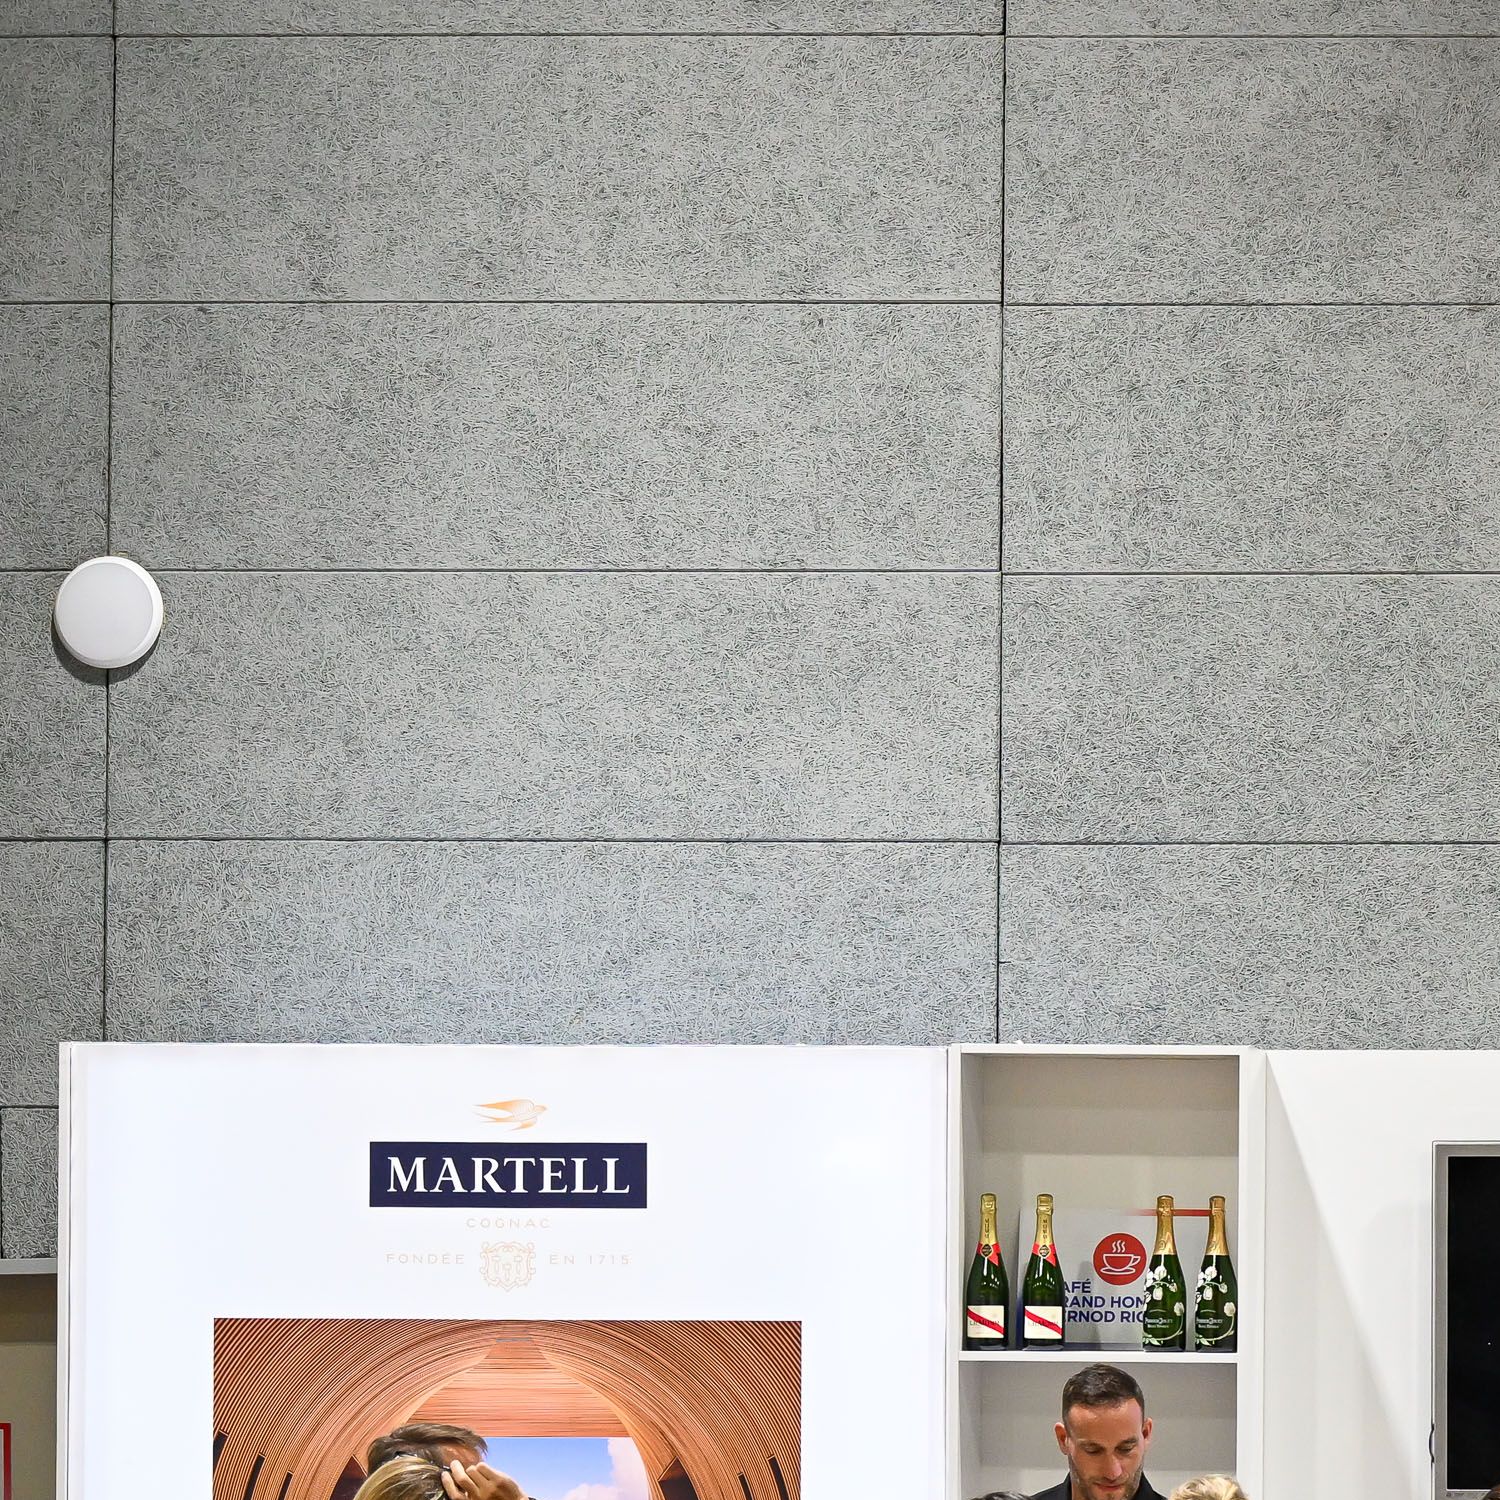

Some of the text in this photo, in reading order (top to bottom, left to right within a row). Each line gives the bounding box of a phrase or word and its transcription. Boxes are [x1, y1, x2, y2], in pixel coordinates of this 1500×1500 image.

[386, 1156, 630, 1194] MARTELL
[466, 1217, 551, 1229] COGNAC
[549, 1254, 575, 1265] EN
[589, 1254, 629, 1265] 1715
[1064, 1279, 1091, 1293] AFÉ
